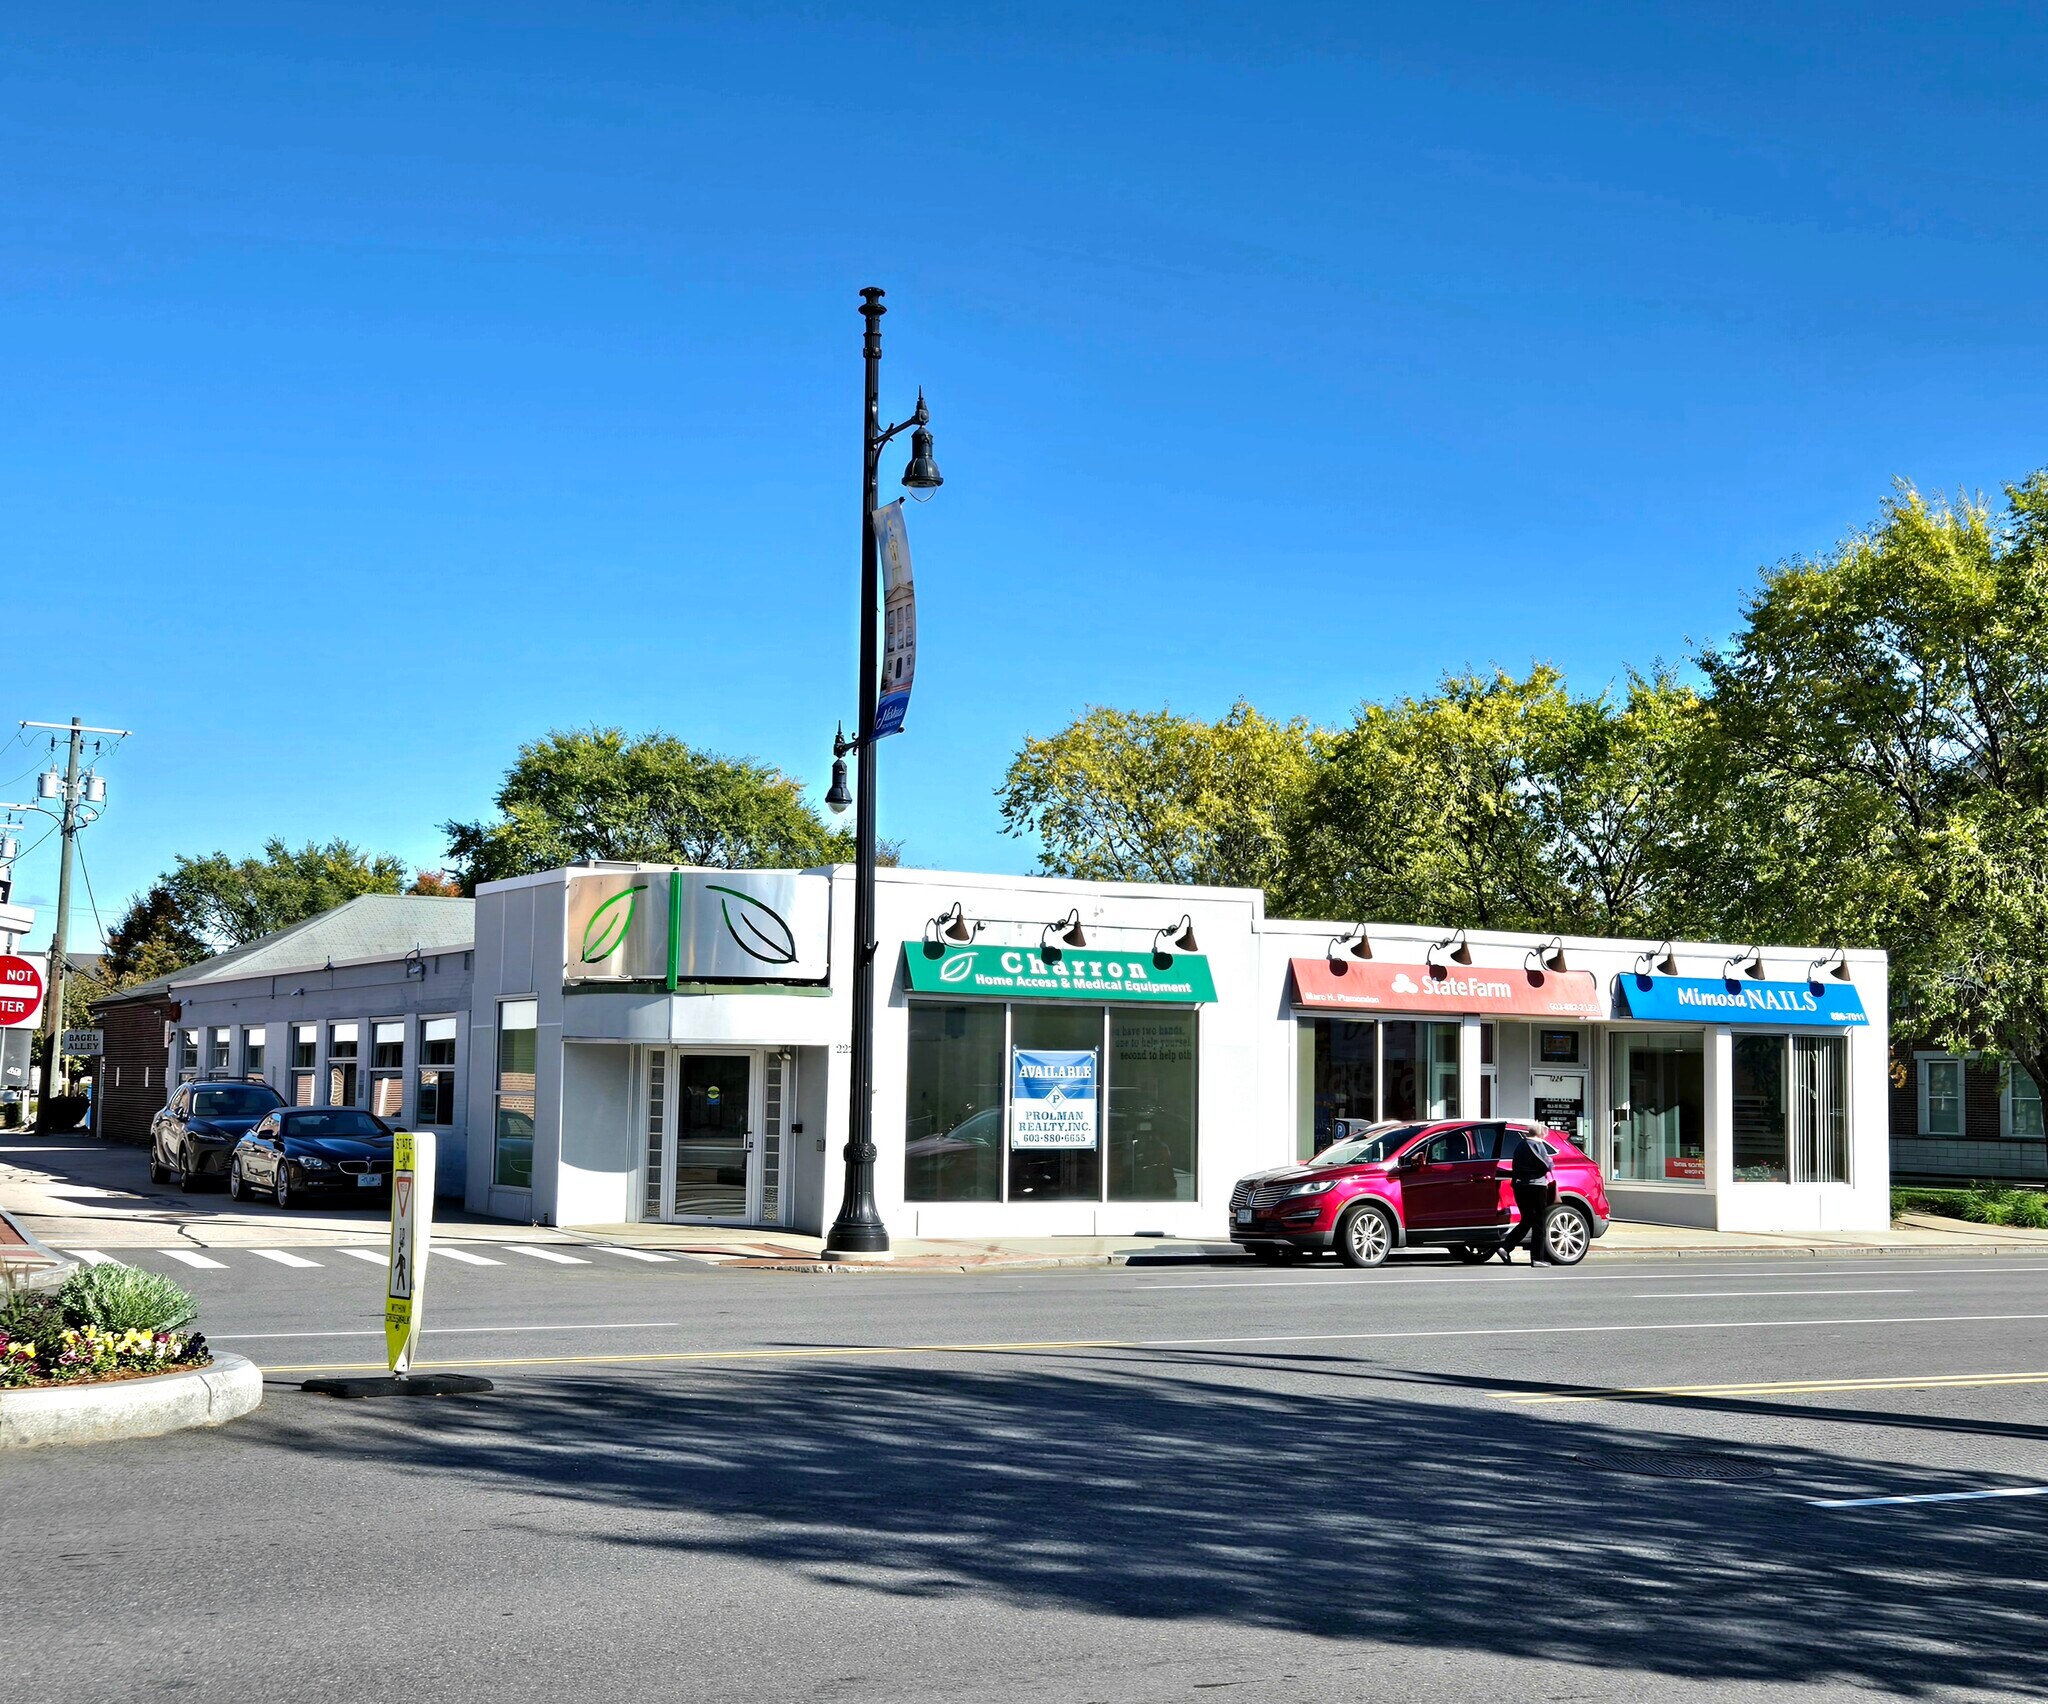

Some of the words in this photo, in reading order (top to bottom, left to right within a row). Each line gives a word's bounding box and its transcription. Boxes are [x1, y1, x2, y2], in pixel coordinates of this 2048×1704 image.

[1000, 951, 1148, 979] Charron
[6, 969, 34, 982] NOT
[975, 974, 1013, 986] Home
[1016, 977, 1059, 989] Access
[1061, 978, 1071, 989] &
[1074, 978, 1122, 991] Medical
[1125, 980, 1192, 994] Equipment
[68, 1034, 99, 1042] BAGEL
[1159, 1049, 1177, 1062] help
[1018, 1066, 1092, 1078] AVAILABLE
[1052, 1095, 1060, 1104] P
[1025, 1111, 1084, 1121] PROLMAN
